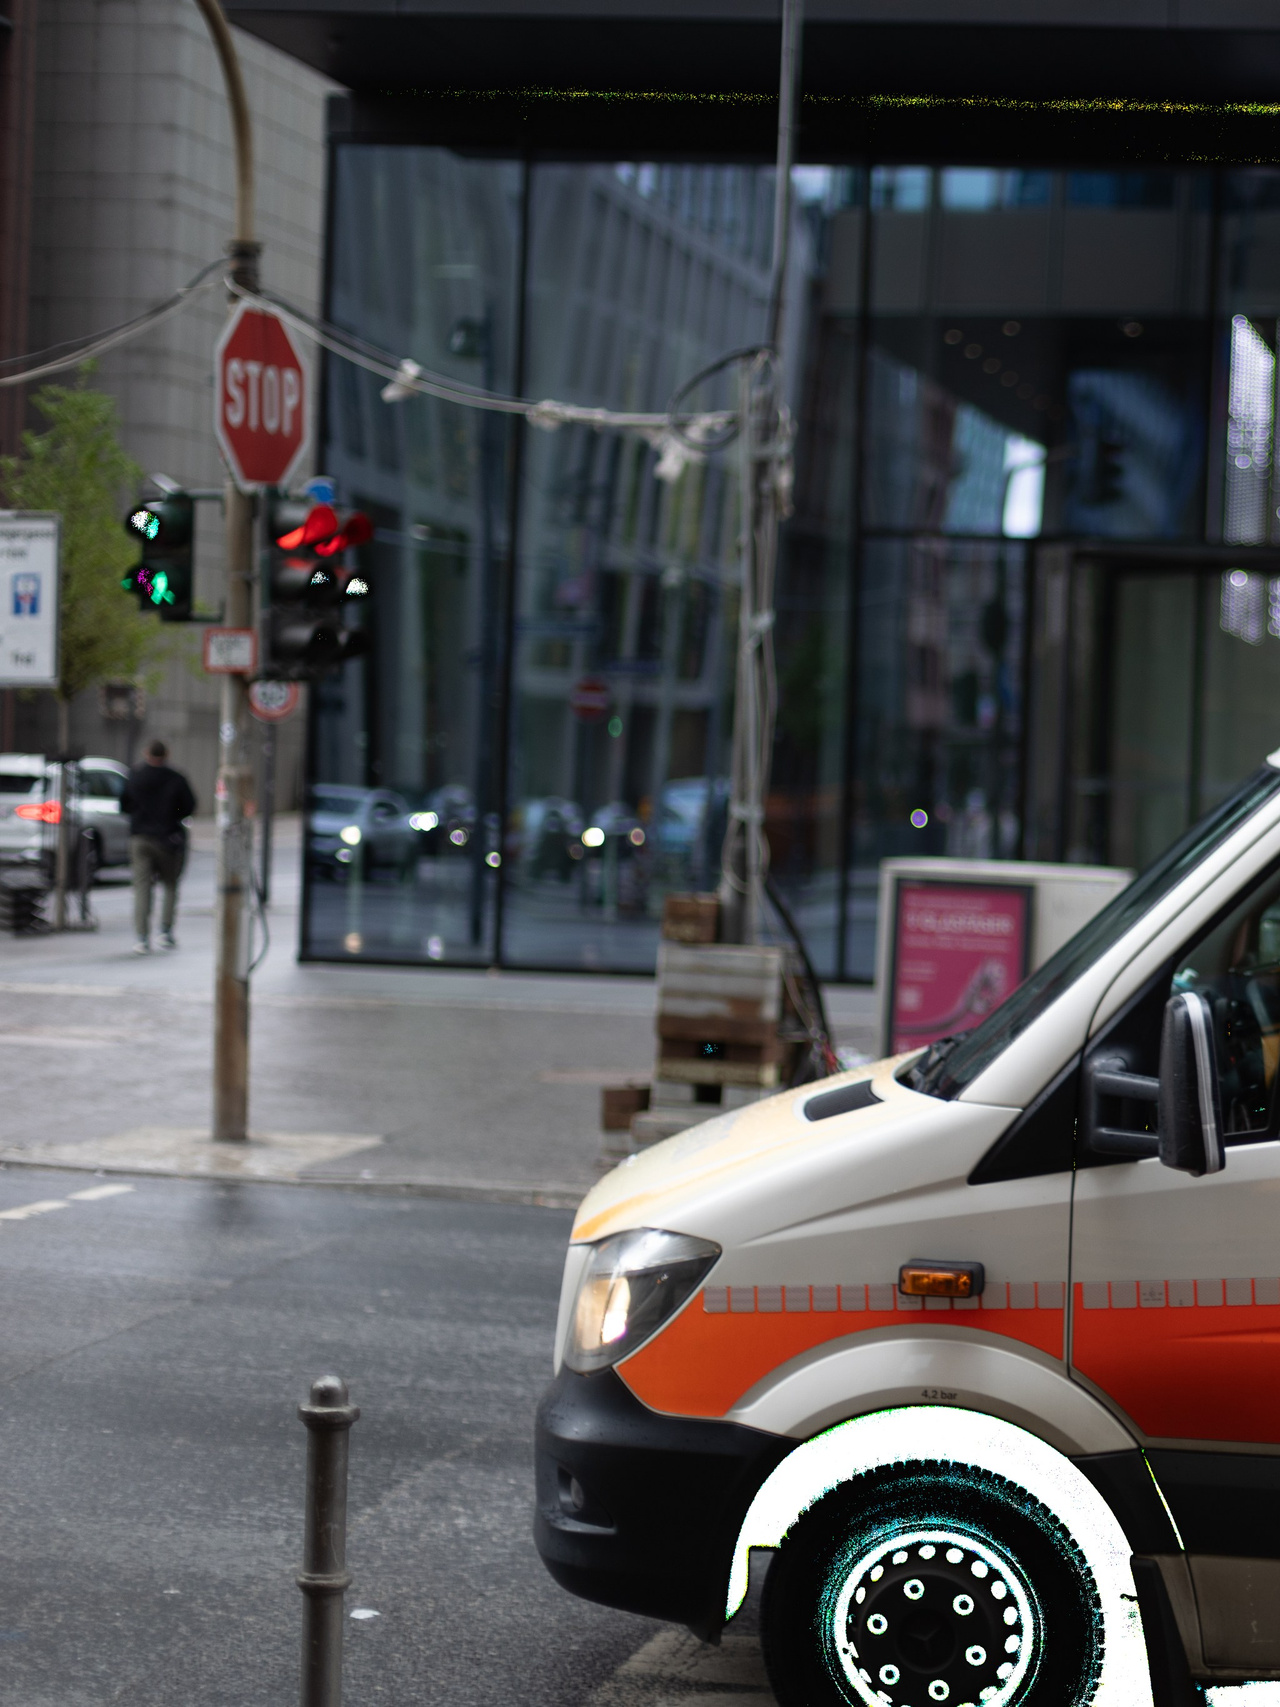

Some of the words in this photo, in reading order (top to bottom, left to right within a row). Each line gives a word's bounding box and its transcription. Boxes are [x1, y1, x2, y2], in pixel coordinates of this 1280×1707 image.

[226, 357, 300, 437] STOP
[921, 1389, 938, 1400] 4,2
[940, 1390, 958, 1400] bar
